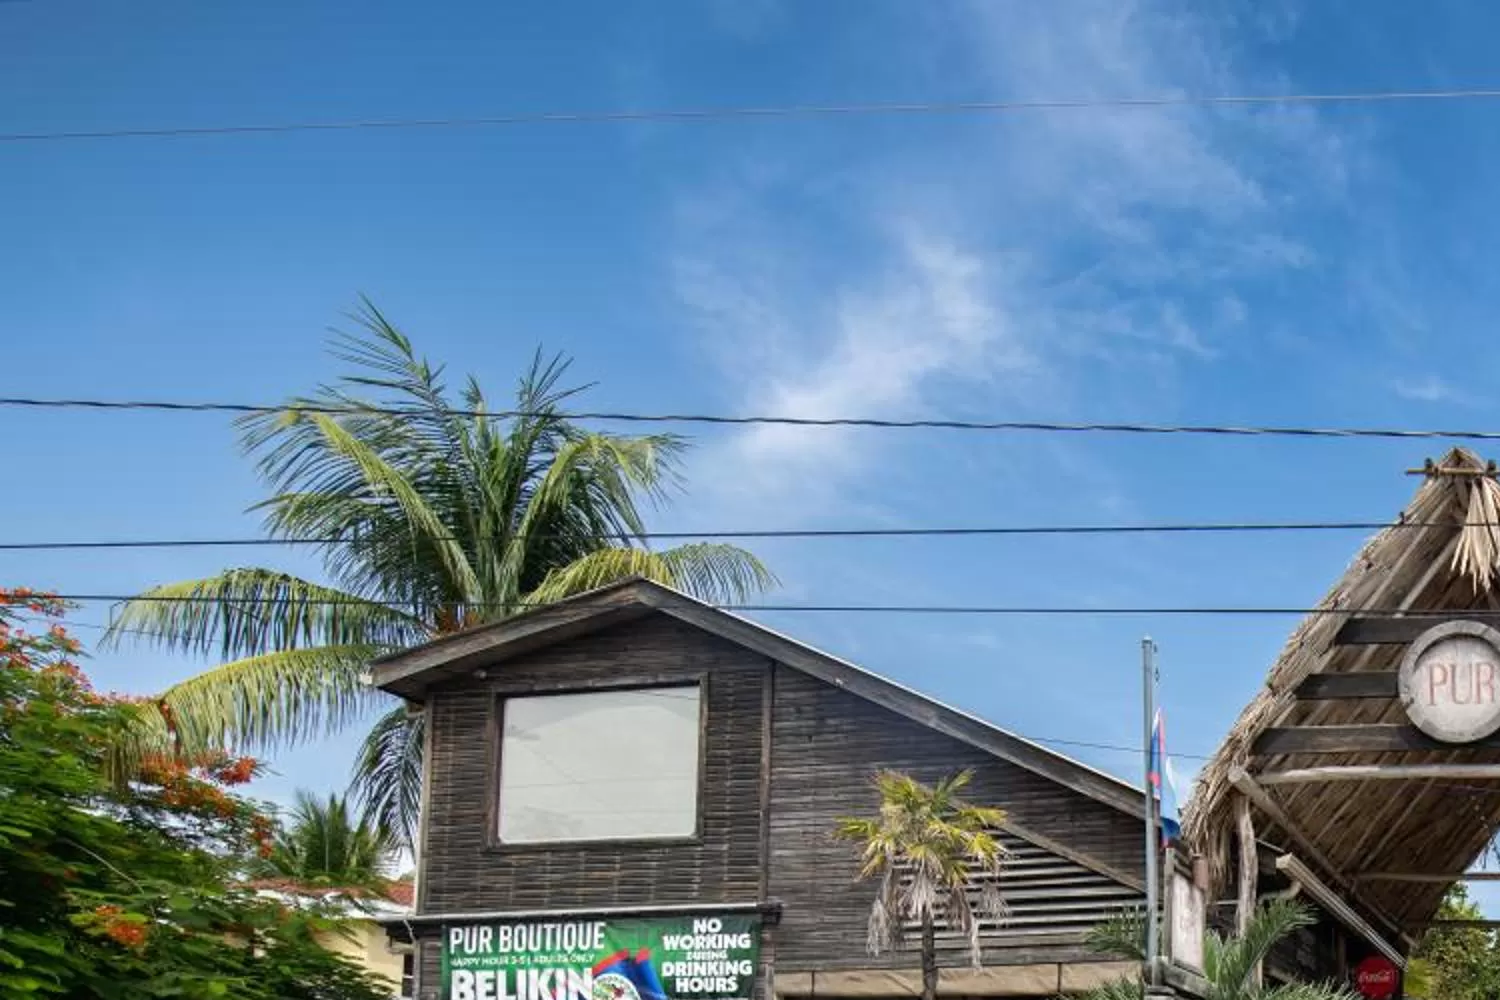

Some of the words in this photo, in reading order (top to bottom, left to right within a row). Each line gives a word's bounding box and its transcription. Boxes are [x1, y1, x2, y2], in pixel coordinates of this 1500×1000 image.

[1427, 662, 1496, 706] PUR
[693, 918, 722, 933] NO
[450, 926, 493, 953] PUR
[499, 922, 606, 953] BOUTIQUE
[663, 934, 751, 950] WORKING
[451, 957, 479, 967] HAPPY
[482, 956, 509, 965] HOUR
[686, 950, 728, 960] DURING
[662, 961, 753, 977] DRINKING
[675, 976, 738, 993] HOURS
